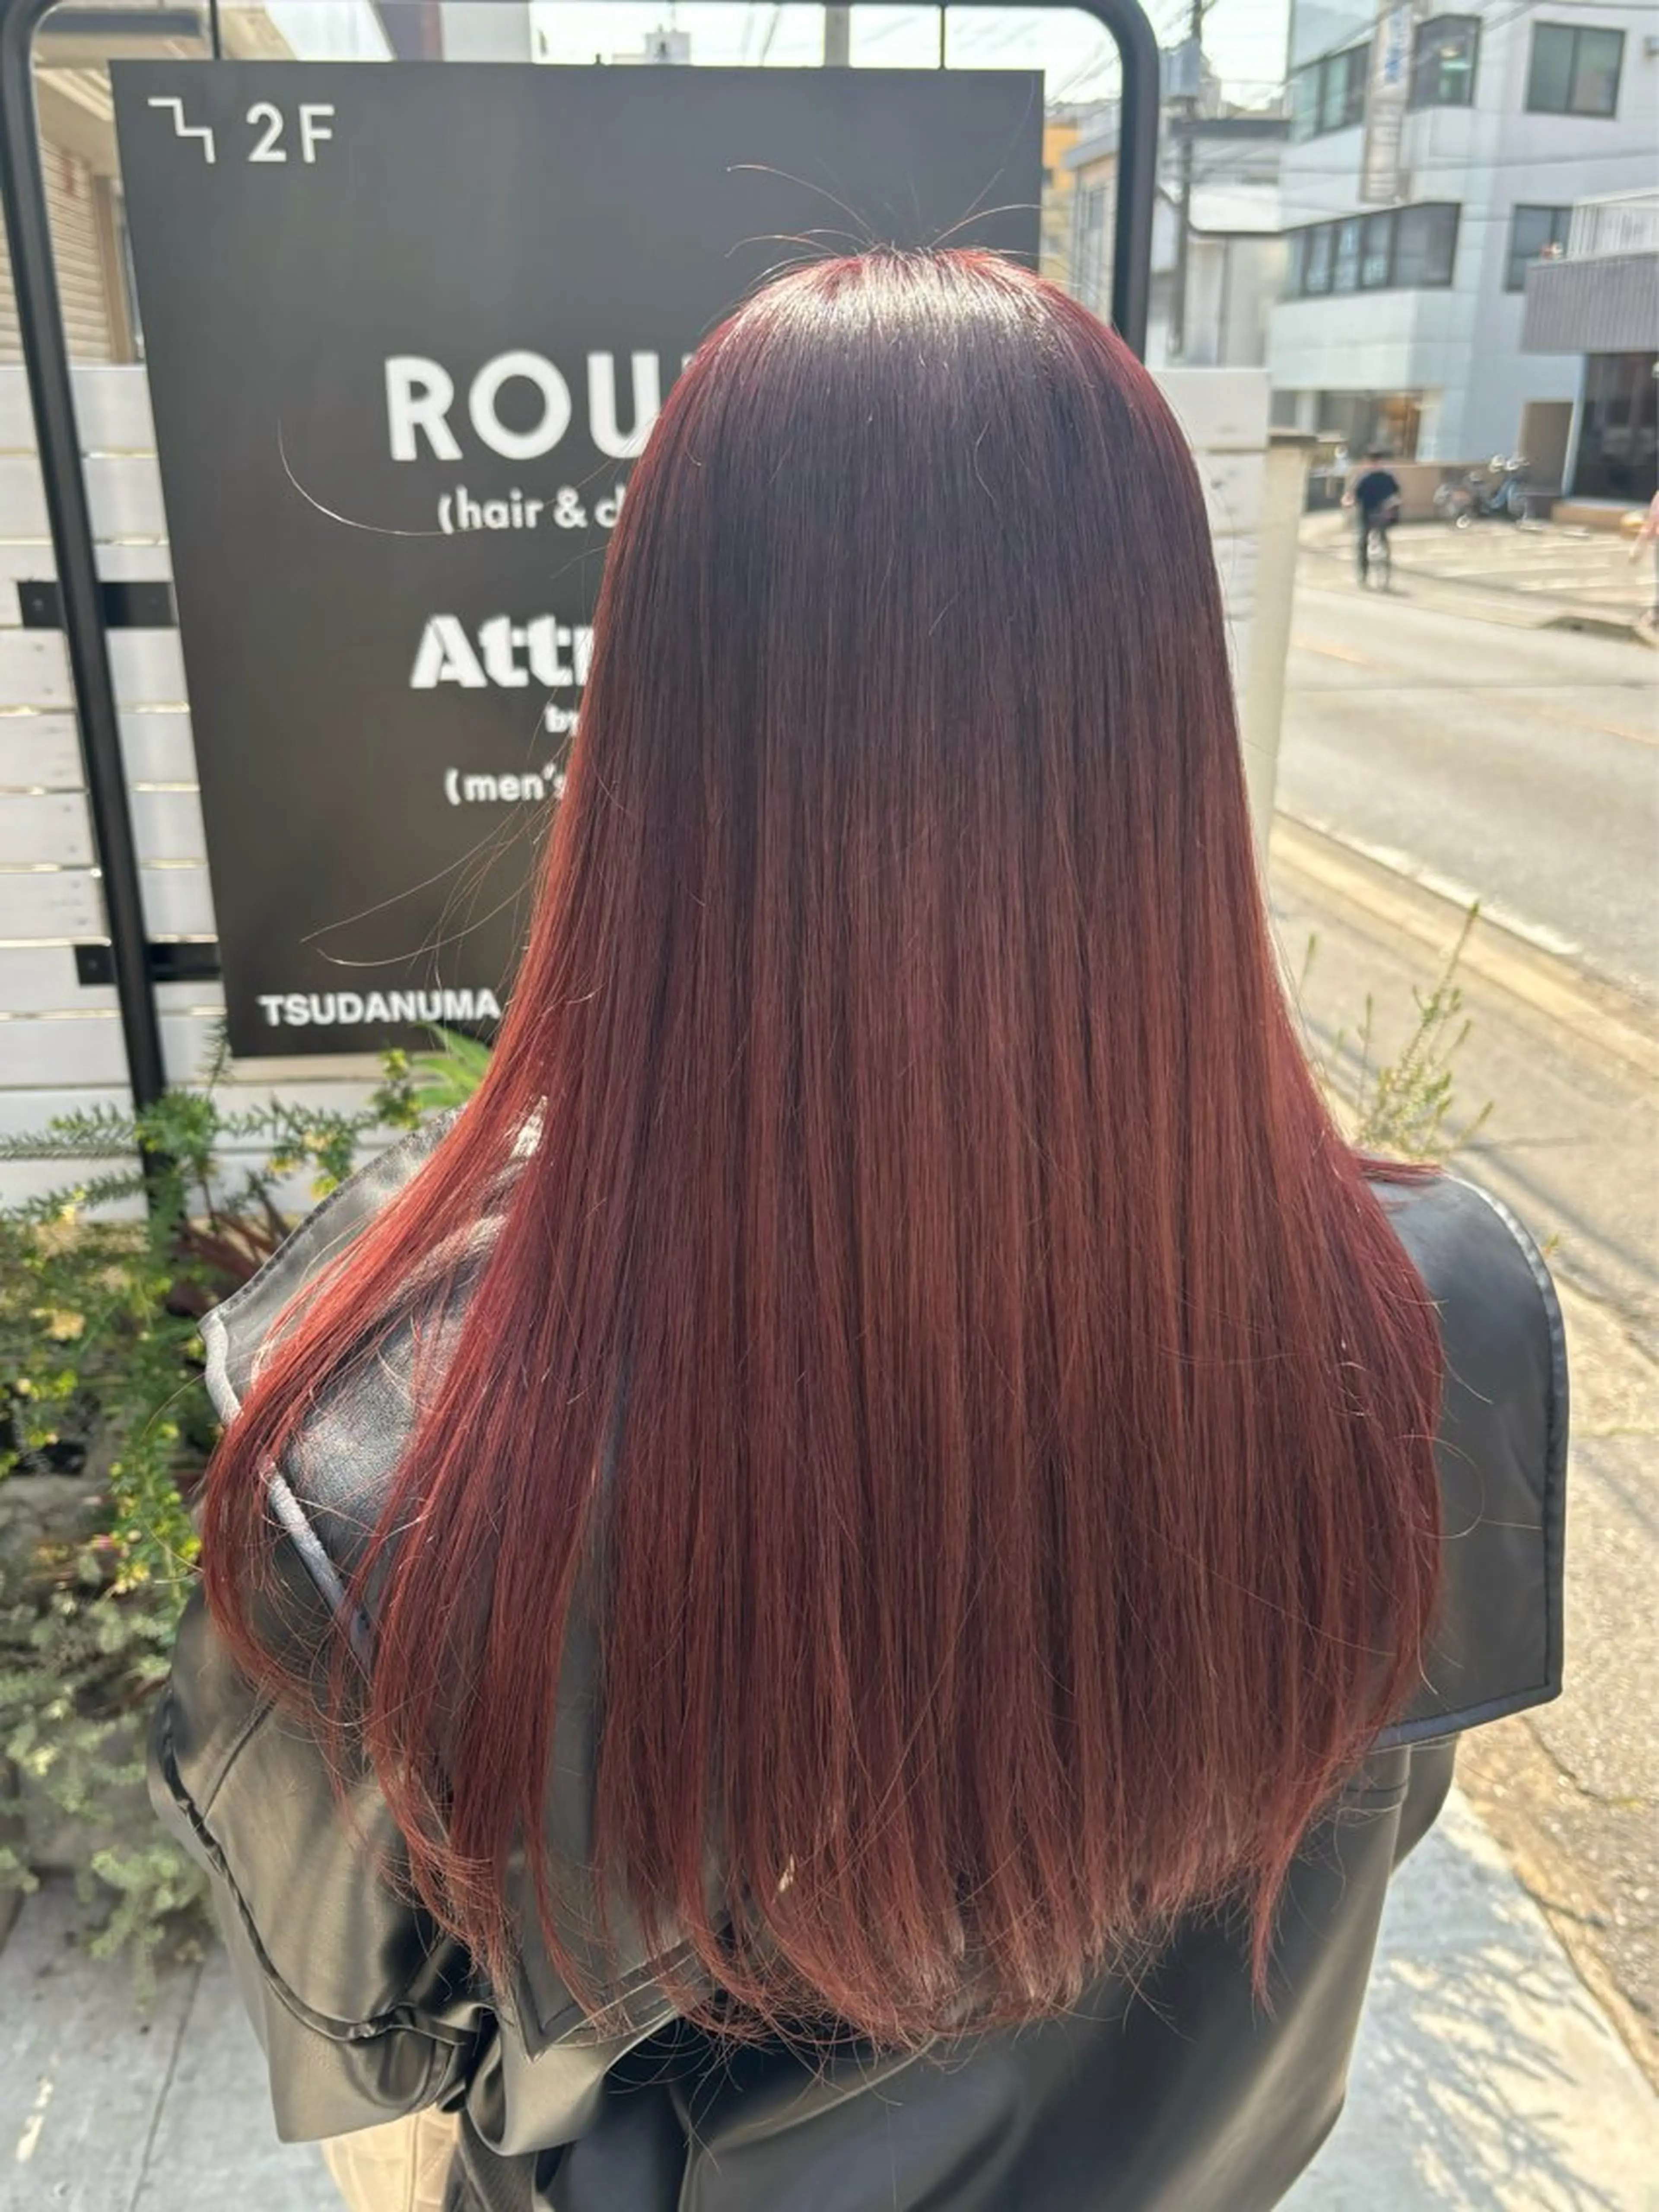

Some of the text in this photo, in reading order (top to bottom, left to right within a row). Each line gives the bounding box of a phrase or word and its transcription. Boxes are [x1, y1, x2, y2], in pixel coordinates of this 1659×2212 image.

[246, 101, 335, 163] 2F
[384, 350, 696, 461] ROU
[438, 484, 543, 535] (hair
[553, 486, 588, 529] &
[258, 987, 501, 1027] TSUDANUMA
